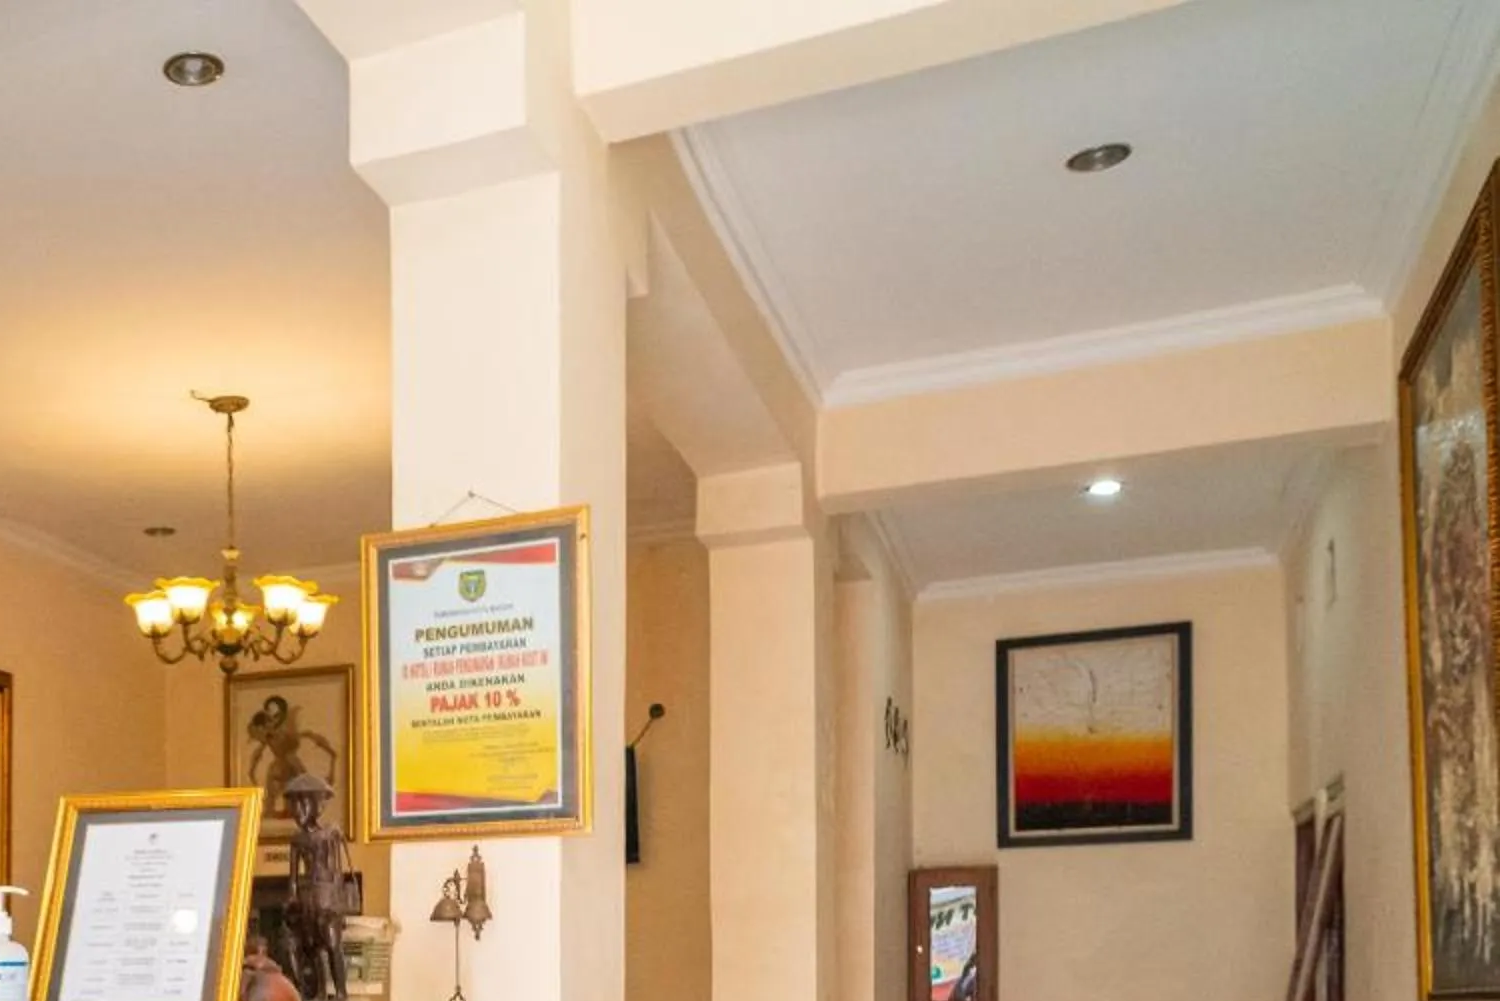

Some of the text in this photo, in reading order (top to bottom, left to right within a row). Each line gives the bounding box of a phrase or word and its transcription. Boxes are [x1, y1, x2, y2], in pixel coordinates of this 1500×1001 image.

[414, 616, 534, 643] PENGUMUMAN
[423, 637, 527, 659] SETIAP PEMBAYARAN
[426, 673, 526, 692] ANDA DIKENAKAN
[430, 689, 521, 713] PAJAK 10 %
